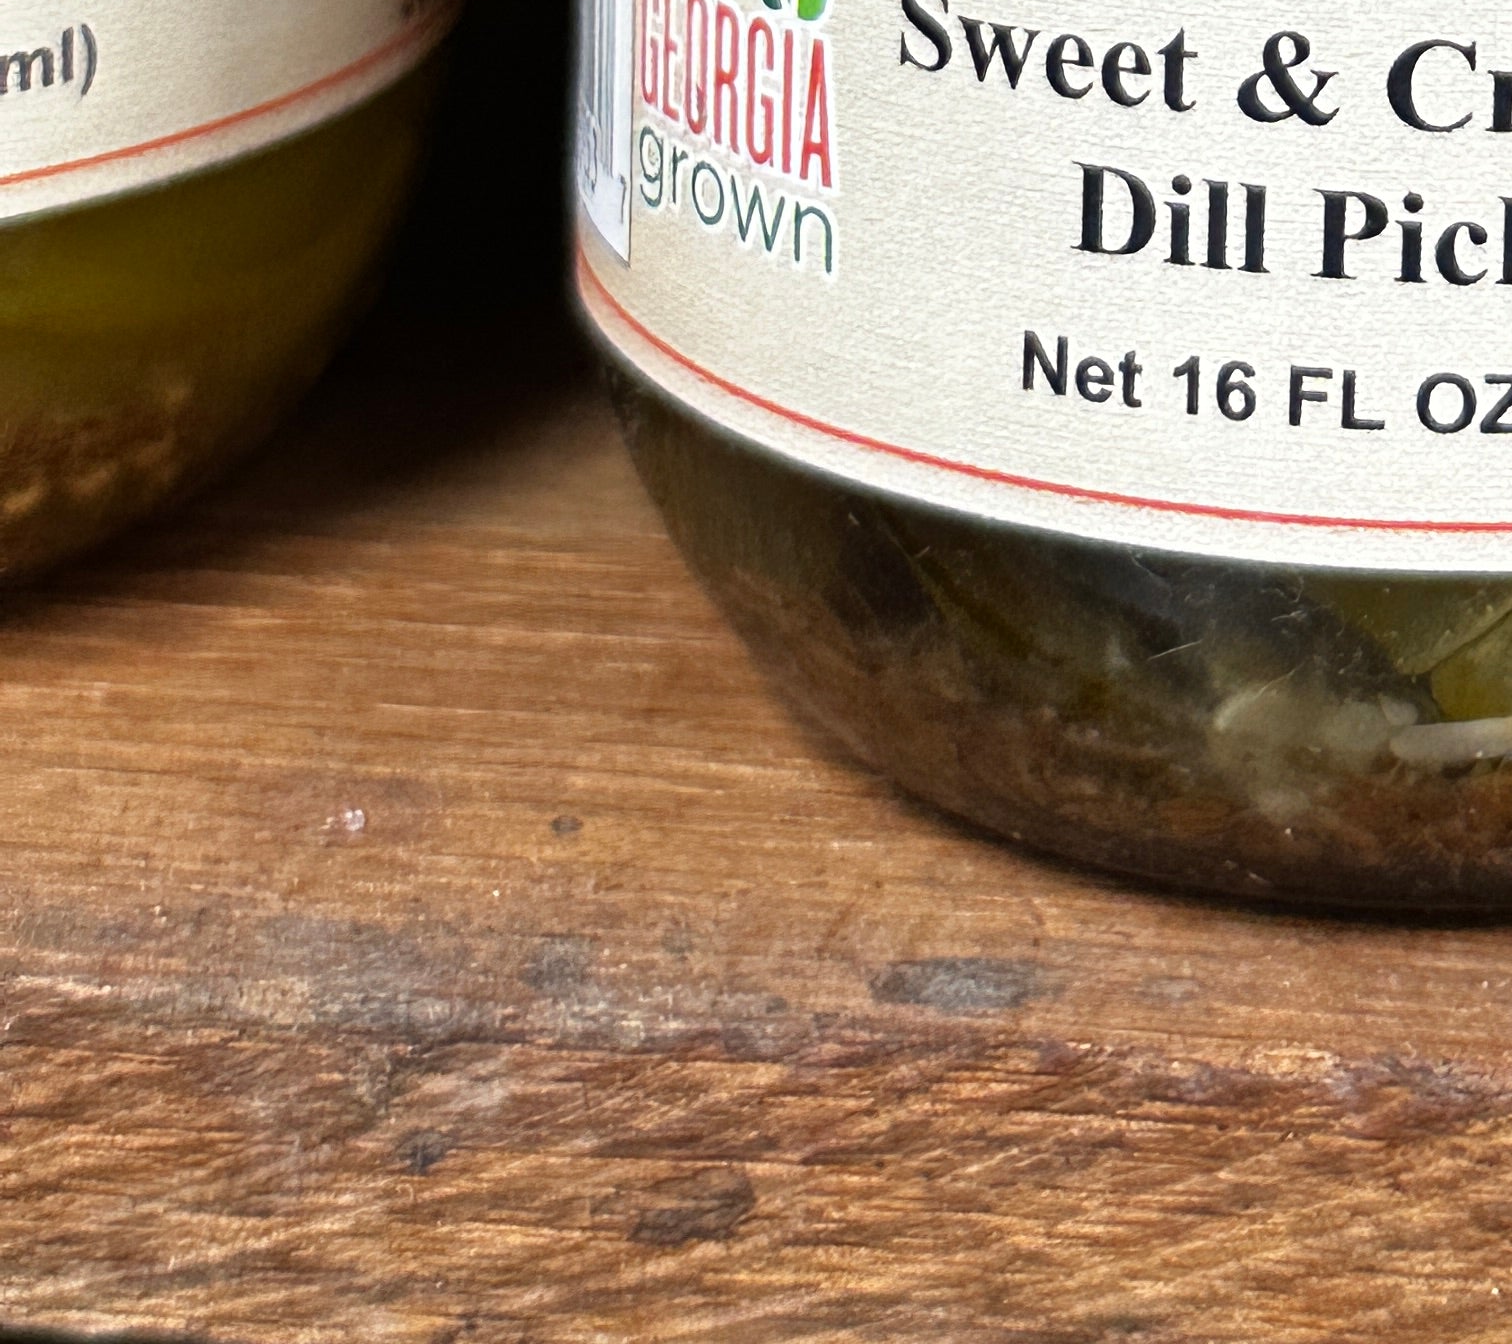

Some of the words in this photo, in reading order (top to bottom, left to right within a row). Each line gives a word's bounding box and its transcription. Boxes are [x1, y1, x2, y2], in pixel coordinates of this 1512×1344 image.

[1237, 30, 1341, 126] &
[639, 126, 832, 274] grown
[1070, 160, 1271, 274] Dill
[1022, 330, 1142, 408] Net
[1173, 355, 1257, 421] 16
[1288, 364, 1387, 431] FL
